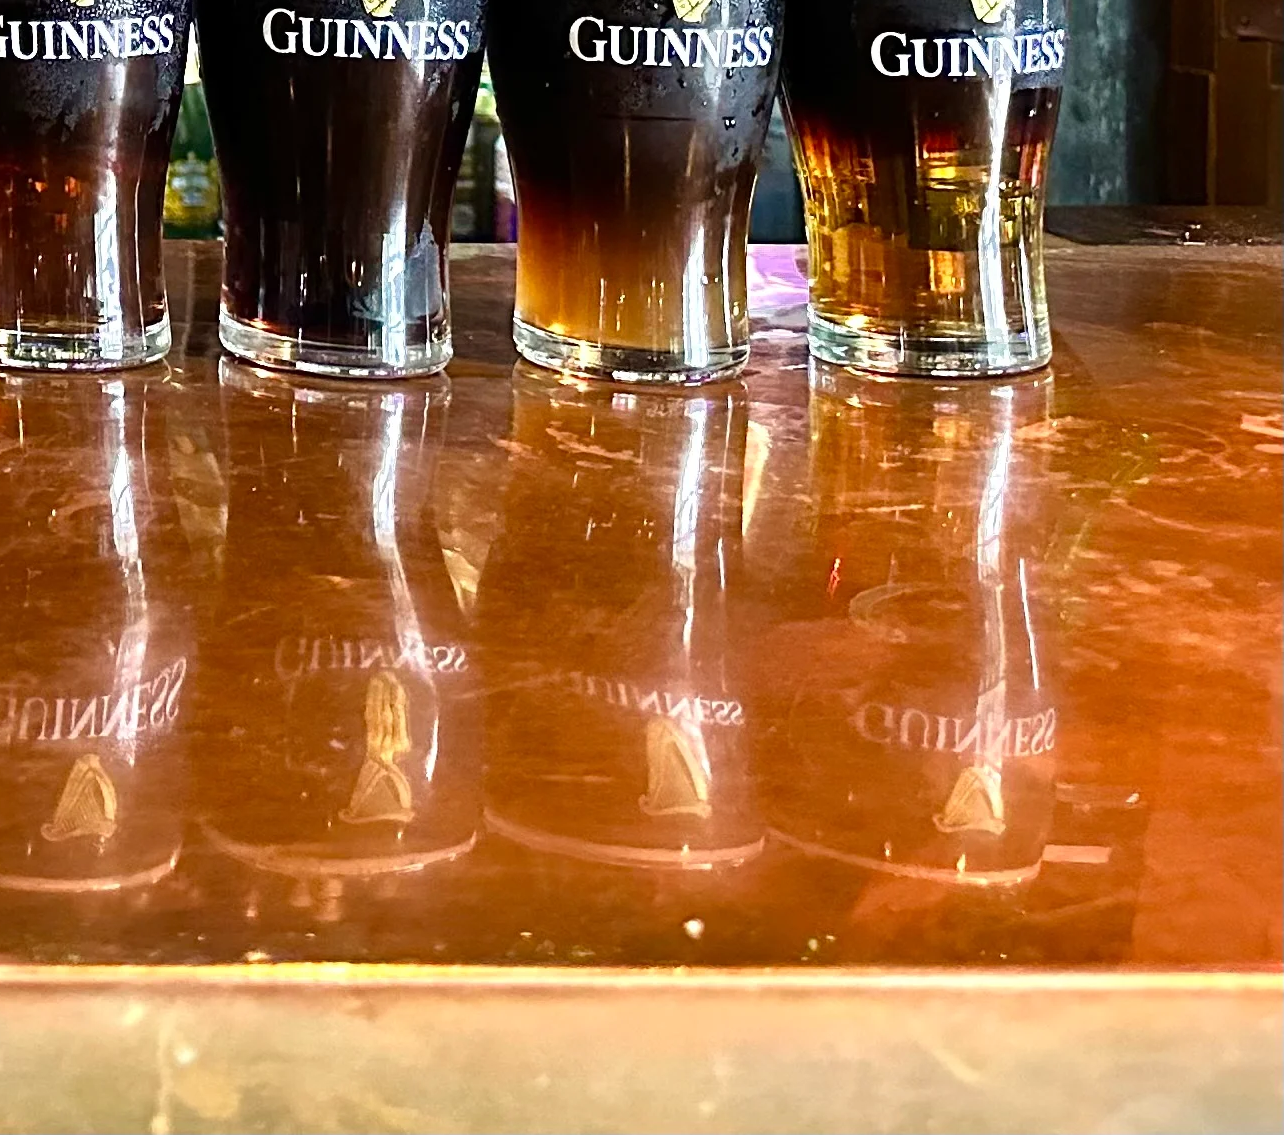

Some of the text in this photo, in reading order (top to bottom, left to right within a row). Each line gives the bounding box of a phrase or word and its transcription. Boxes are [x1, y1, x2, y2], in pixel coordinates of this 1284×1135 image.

[263, 8, 471, 61] GUINNESS
[568, 15, 774, 69] GUINNESS
[870, 28, 1066, 79] GUINNESS
